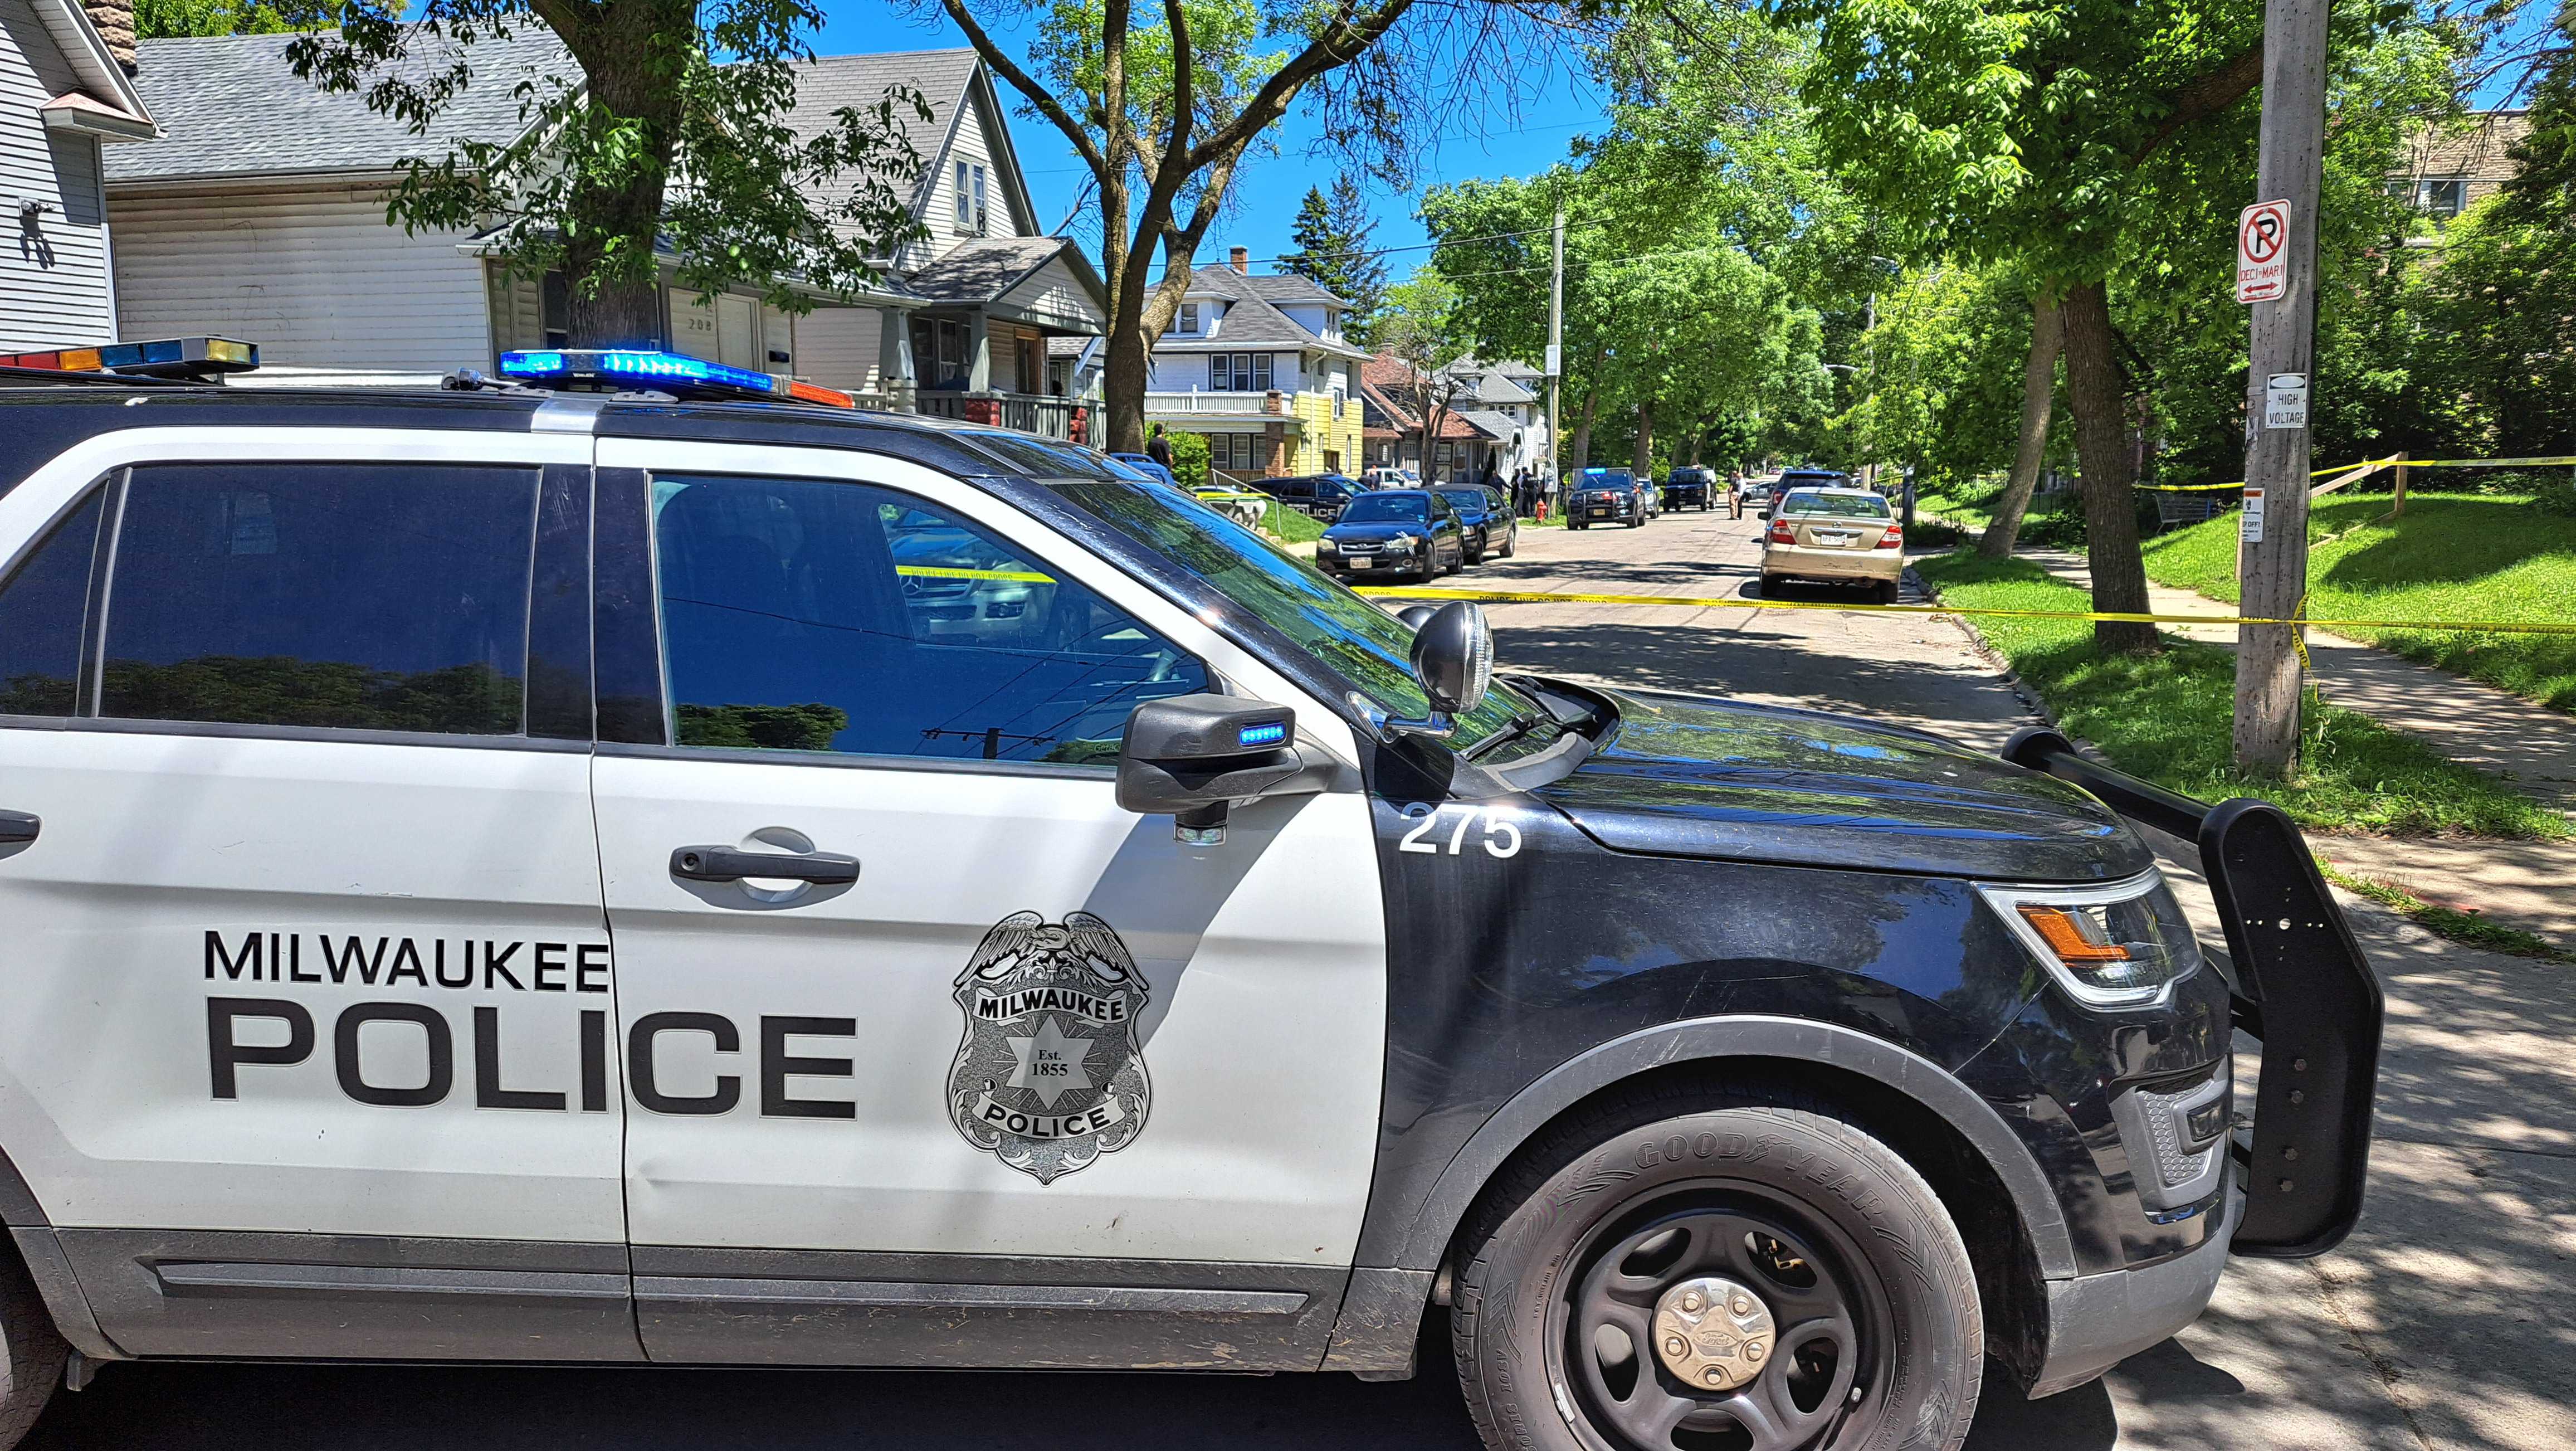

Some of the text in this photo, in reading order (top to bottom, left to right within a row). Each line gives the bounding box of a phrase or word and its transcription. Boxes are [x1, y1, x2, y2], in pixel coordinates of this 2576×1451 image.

[2278, 393, 2299, 406] HIGH
[2269, 412, 2304, 423] VOLTAGE
[1293, 508, 1336, 517] OLICE
[1399, 801, 1522, 858] 275
[204, 930, 609, 994] MILWAUKEE
[979, 989, 1124, 1021] MILWAUKEE
[205, 995, 858, 1121] POLICE
[1038, 1049, 1061, 1060] Est.
[1032, 1063, 1069, 1077] 1855
[983, 1103, 1110, 1138] POLICE
[1702, 1332, 1730, 1346] Ford
